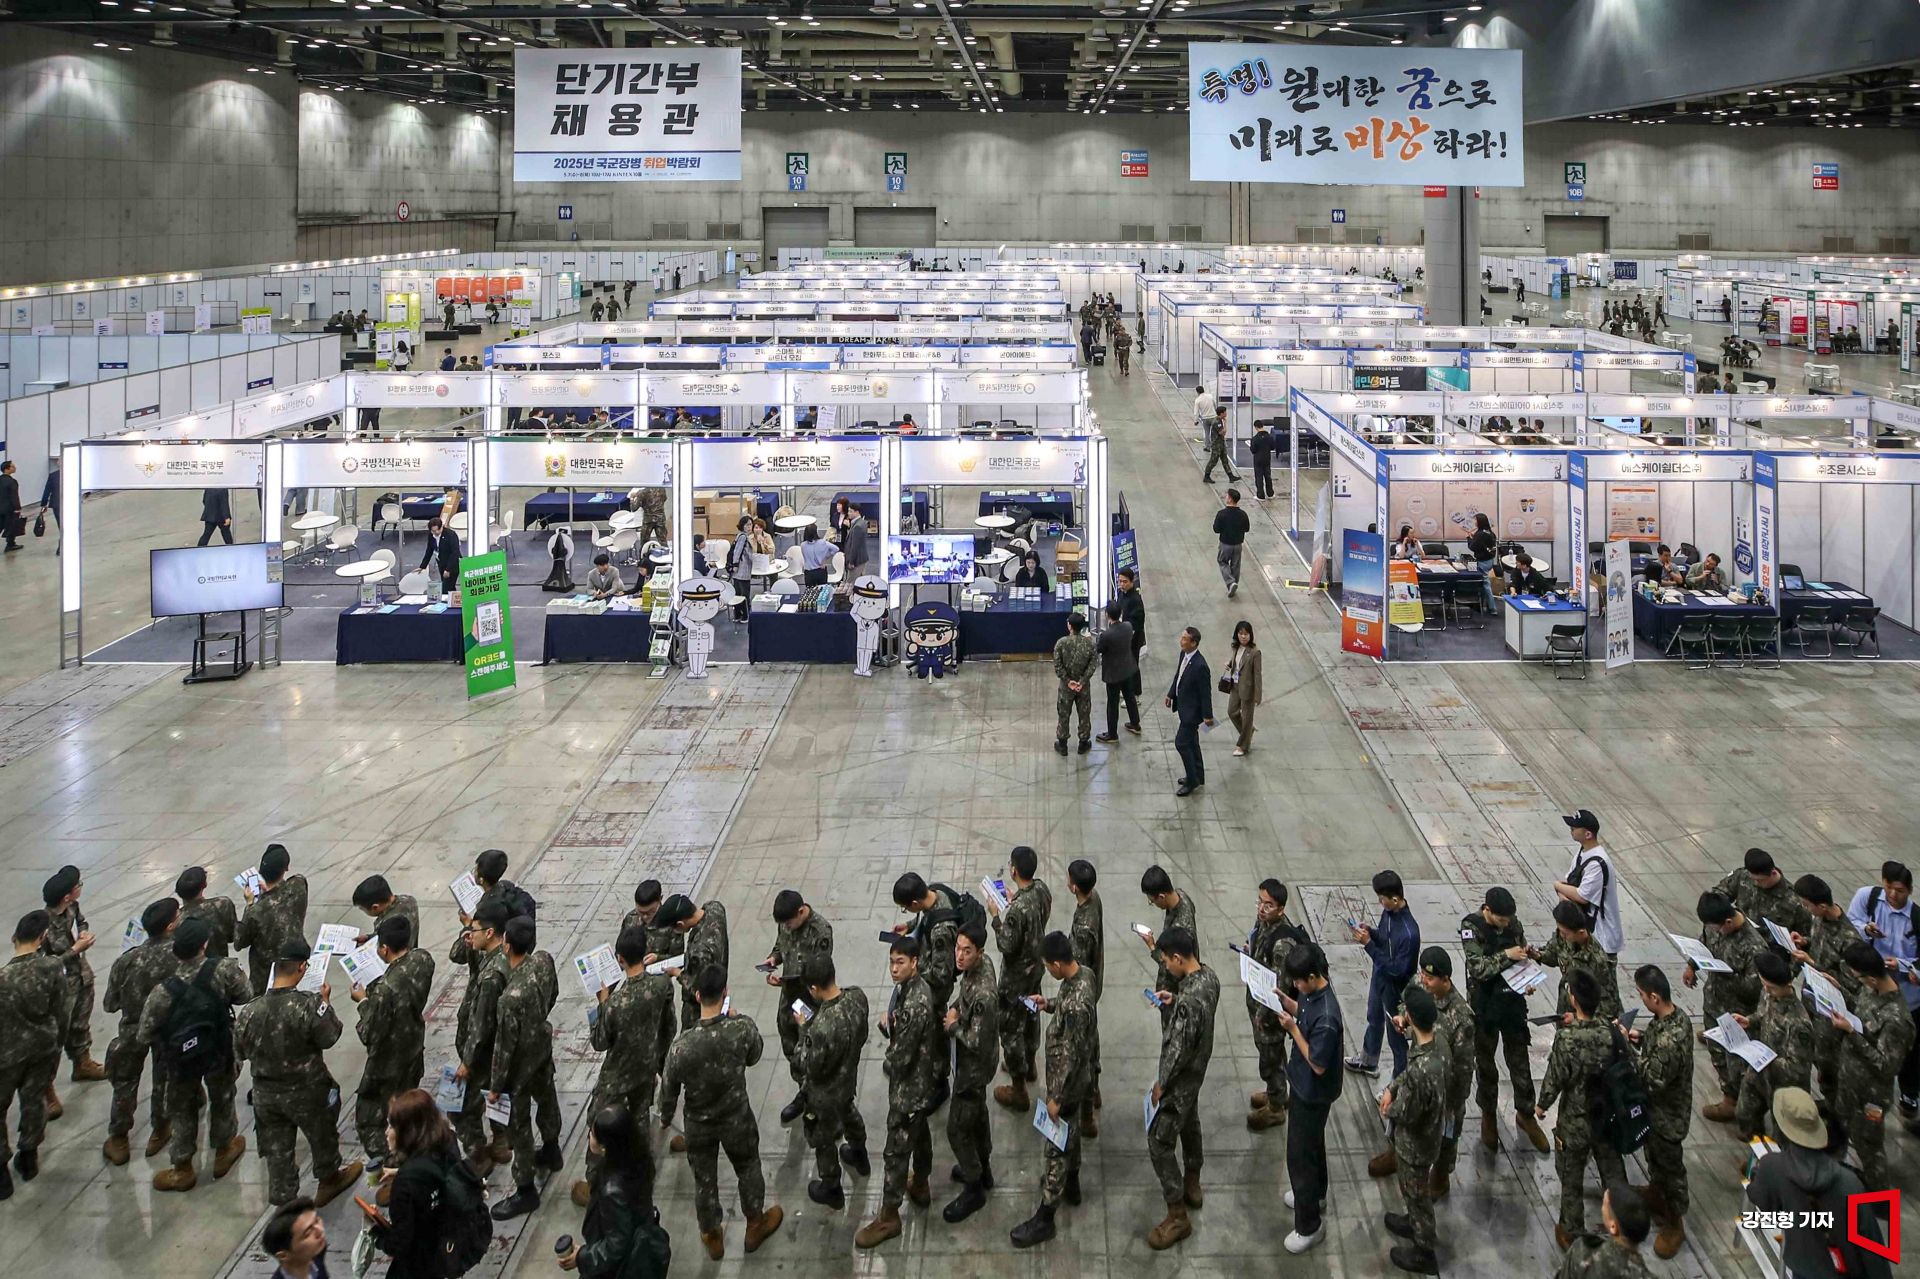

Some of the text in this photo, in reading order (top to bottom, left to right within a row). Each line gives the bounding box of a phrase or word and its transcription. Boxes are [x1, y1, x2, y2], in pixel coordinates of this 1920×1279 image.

[555, 63, 701, 95] 단기간부
[1199, 60, 1497, 113] 특명! 원대한 꿈으로
[550, 103, 699, 136] 채 용 관
[1229, 116, 1507, 162] 미래로 비상하라!
[554, 156, 701, 169] 2025년 국군장병 취업박람회
[1568, 188, 1582, 196] 10B
[167, 461, 224, 470] 대한민국 국방부
[360, 457, 421, 468] 국방전직교육원
[570, 458, 624, 469] 대한민국육군
[767, 456, 830, 467] 대한민국해군
[989, 457, 1040, 467] 대한민국공군
[1738, 552, 1751, 566] ADT
[465, 573, 503, 588] 네이버 밴드
[470, 583, 500, 597] 회원가입
[474, 651, 506, 666] QR코드를
